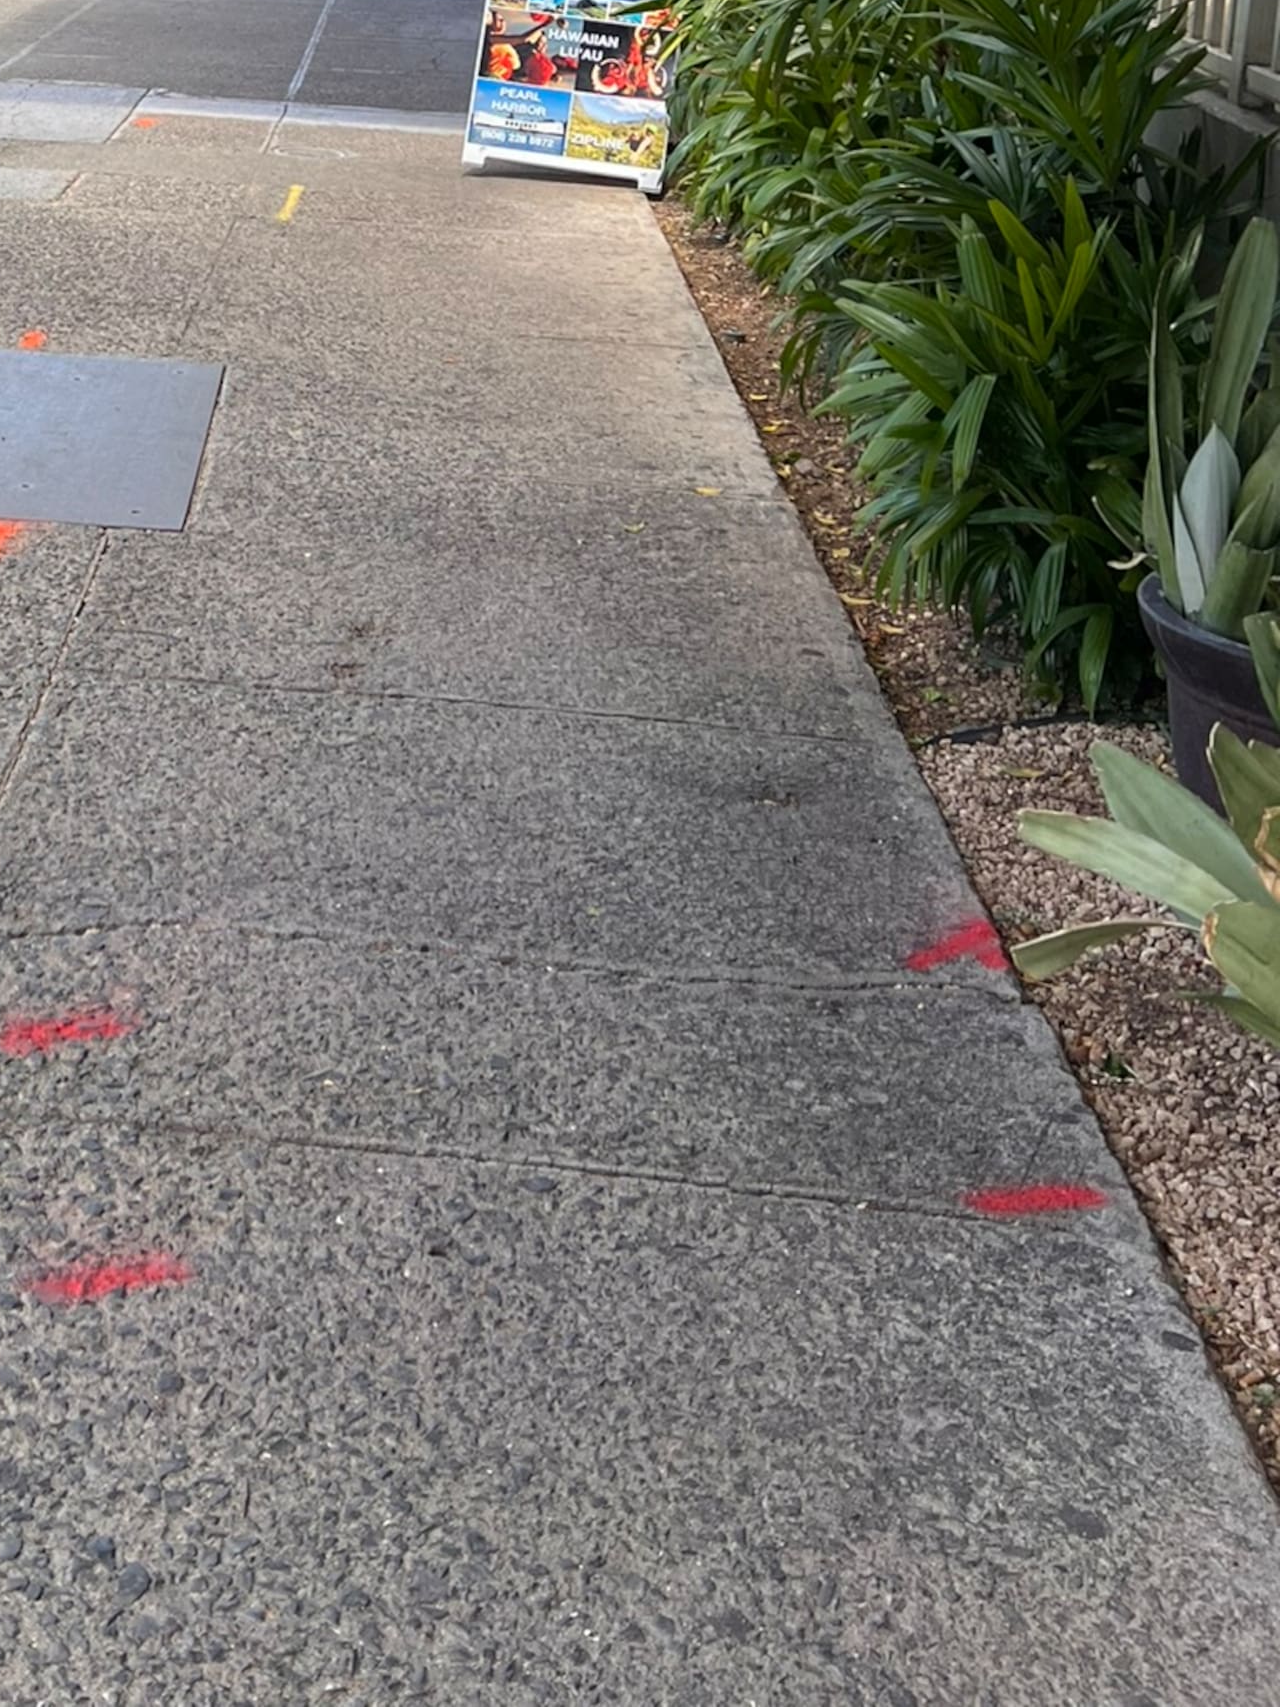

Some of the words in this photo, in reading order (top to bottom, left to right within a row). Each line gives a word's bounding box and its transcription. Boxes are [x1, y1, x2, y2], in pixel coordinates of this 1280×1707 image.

[548, 28, 619, 49] HAWAIIAN
[499, 87, 541, 102] PEARL
[491, 100, 547, 117] HARBOR
